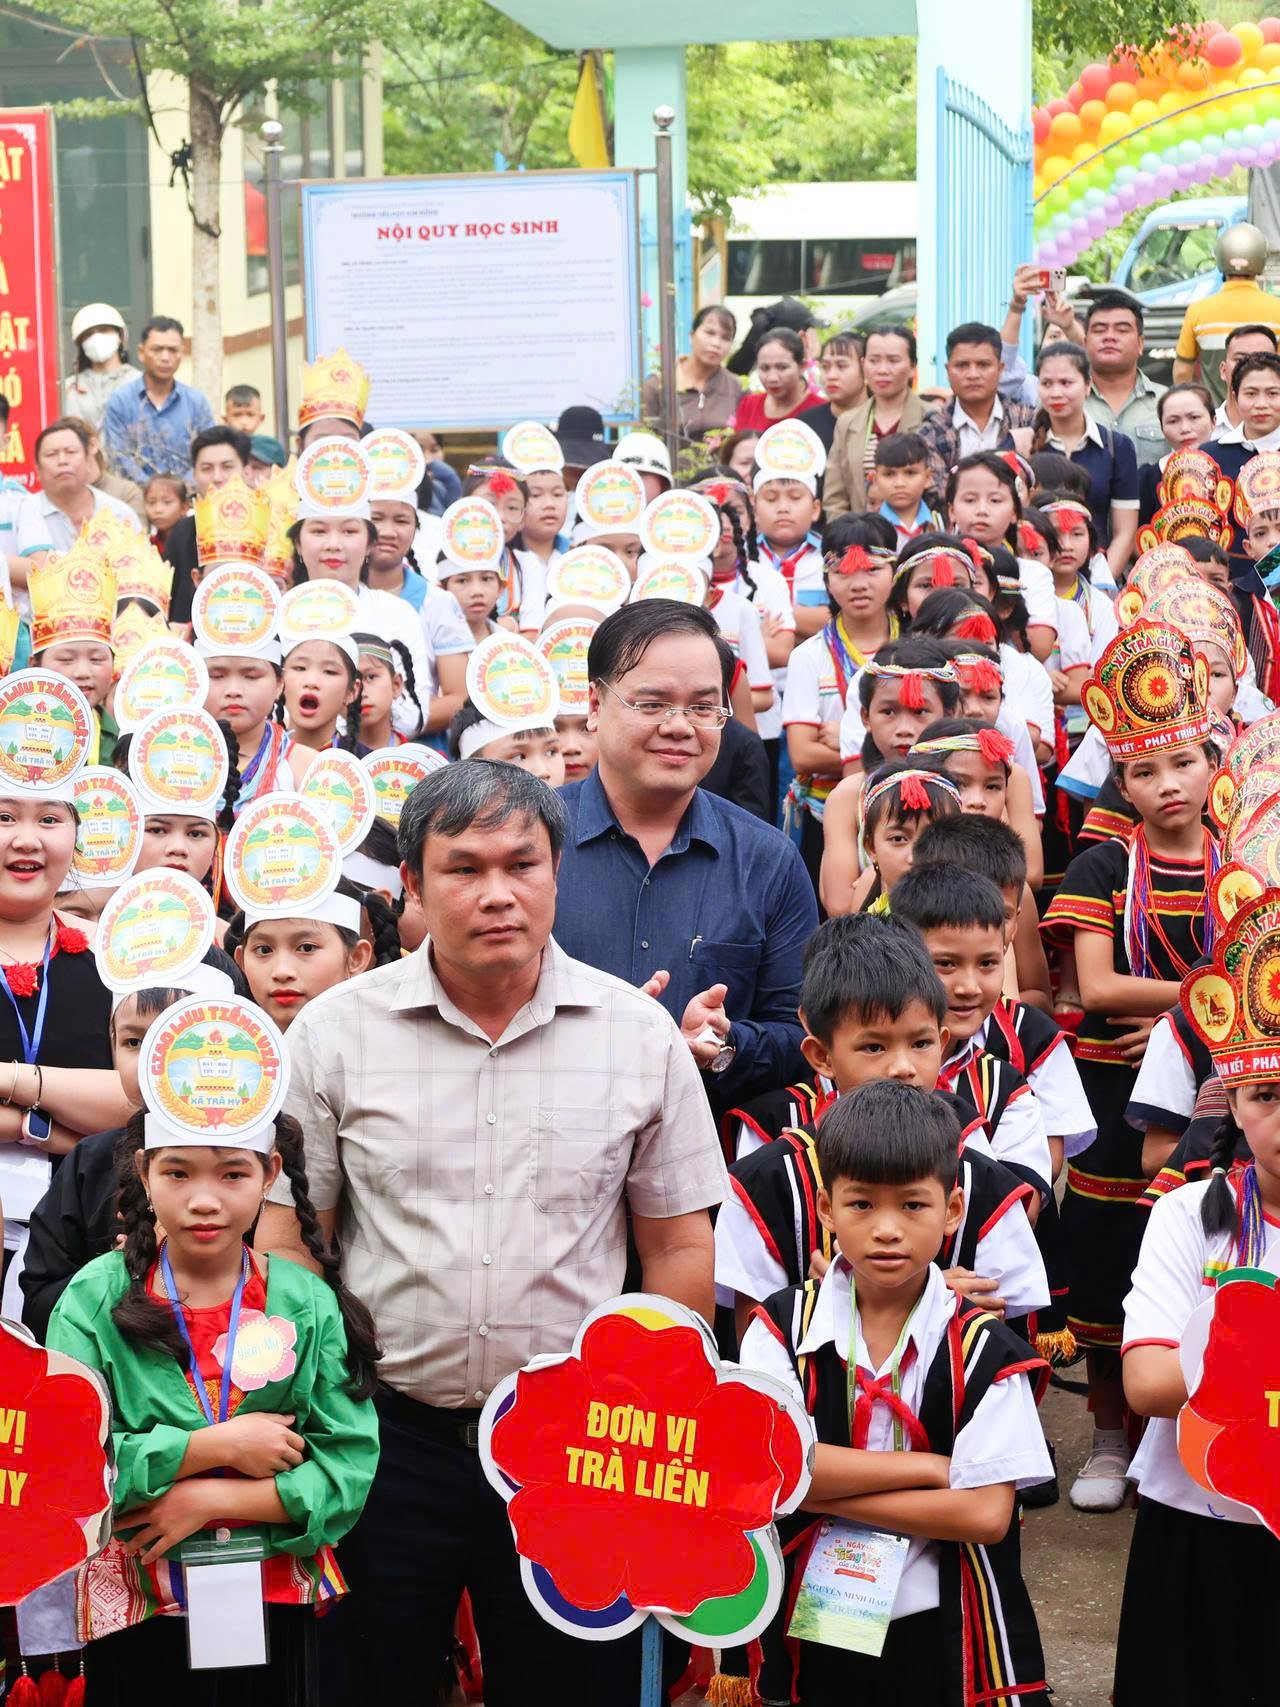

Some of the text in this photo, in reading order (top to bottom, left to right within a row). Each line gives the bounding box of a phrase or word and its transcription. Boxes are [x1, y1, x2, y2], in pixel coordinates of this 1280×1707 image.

[377, 220, 559, 242] NỘI QUY HỌC SINH
[3, 681, 34, 702] LƯU
[37, 680, 78, 710] TIẾNG
[73, 709, 89, 747] VIỆT
[1144, 732, 1174, 749] PHÁT
[90, 776, 129, 800] TIẾNG
[246, 806, 270, 832] LƯU
[272, 801, 317, 826] TIẾNG
[151, 1005, 280, 1080] GIAO LƯU TIẾNG VIỆT
[1230, 1053, 1245, 1074] KẾT
[191, 1095, 241, 1106] XÃ TRÀ MY
[586, 1400, 697, 1463] ĐƠN VỊ
[566, 1446, 710, 1509] TRÀ LIÊN
